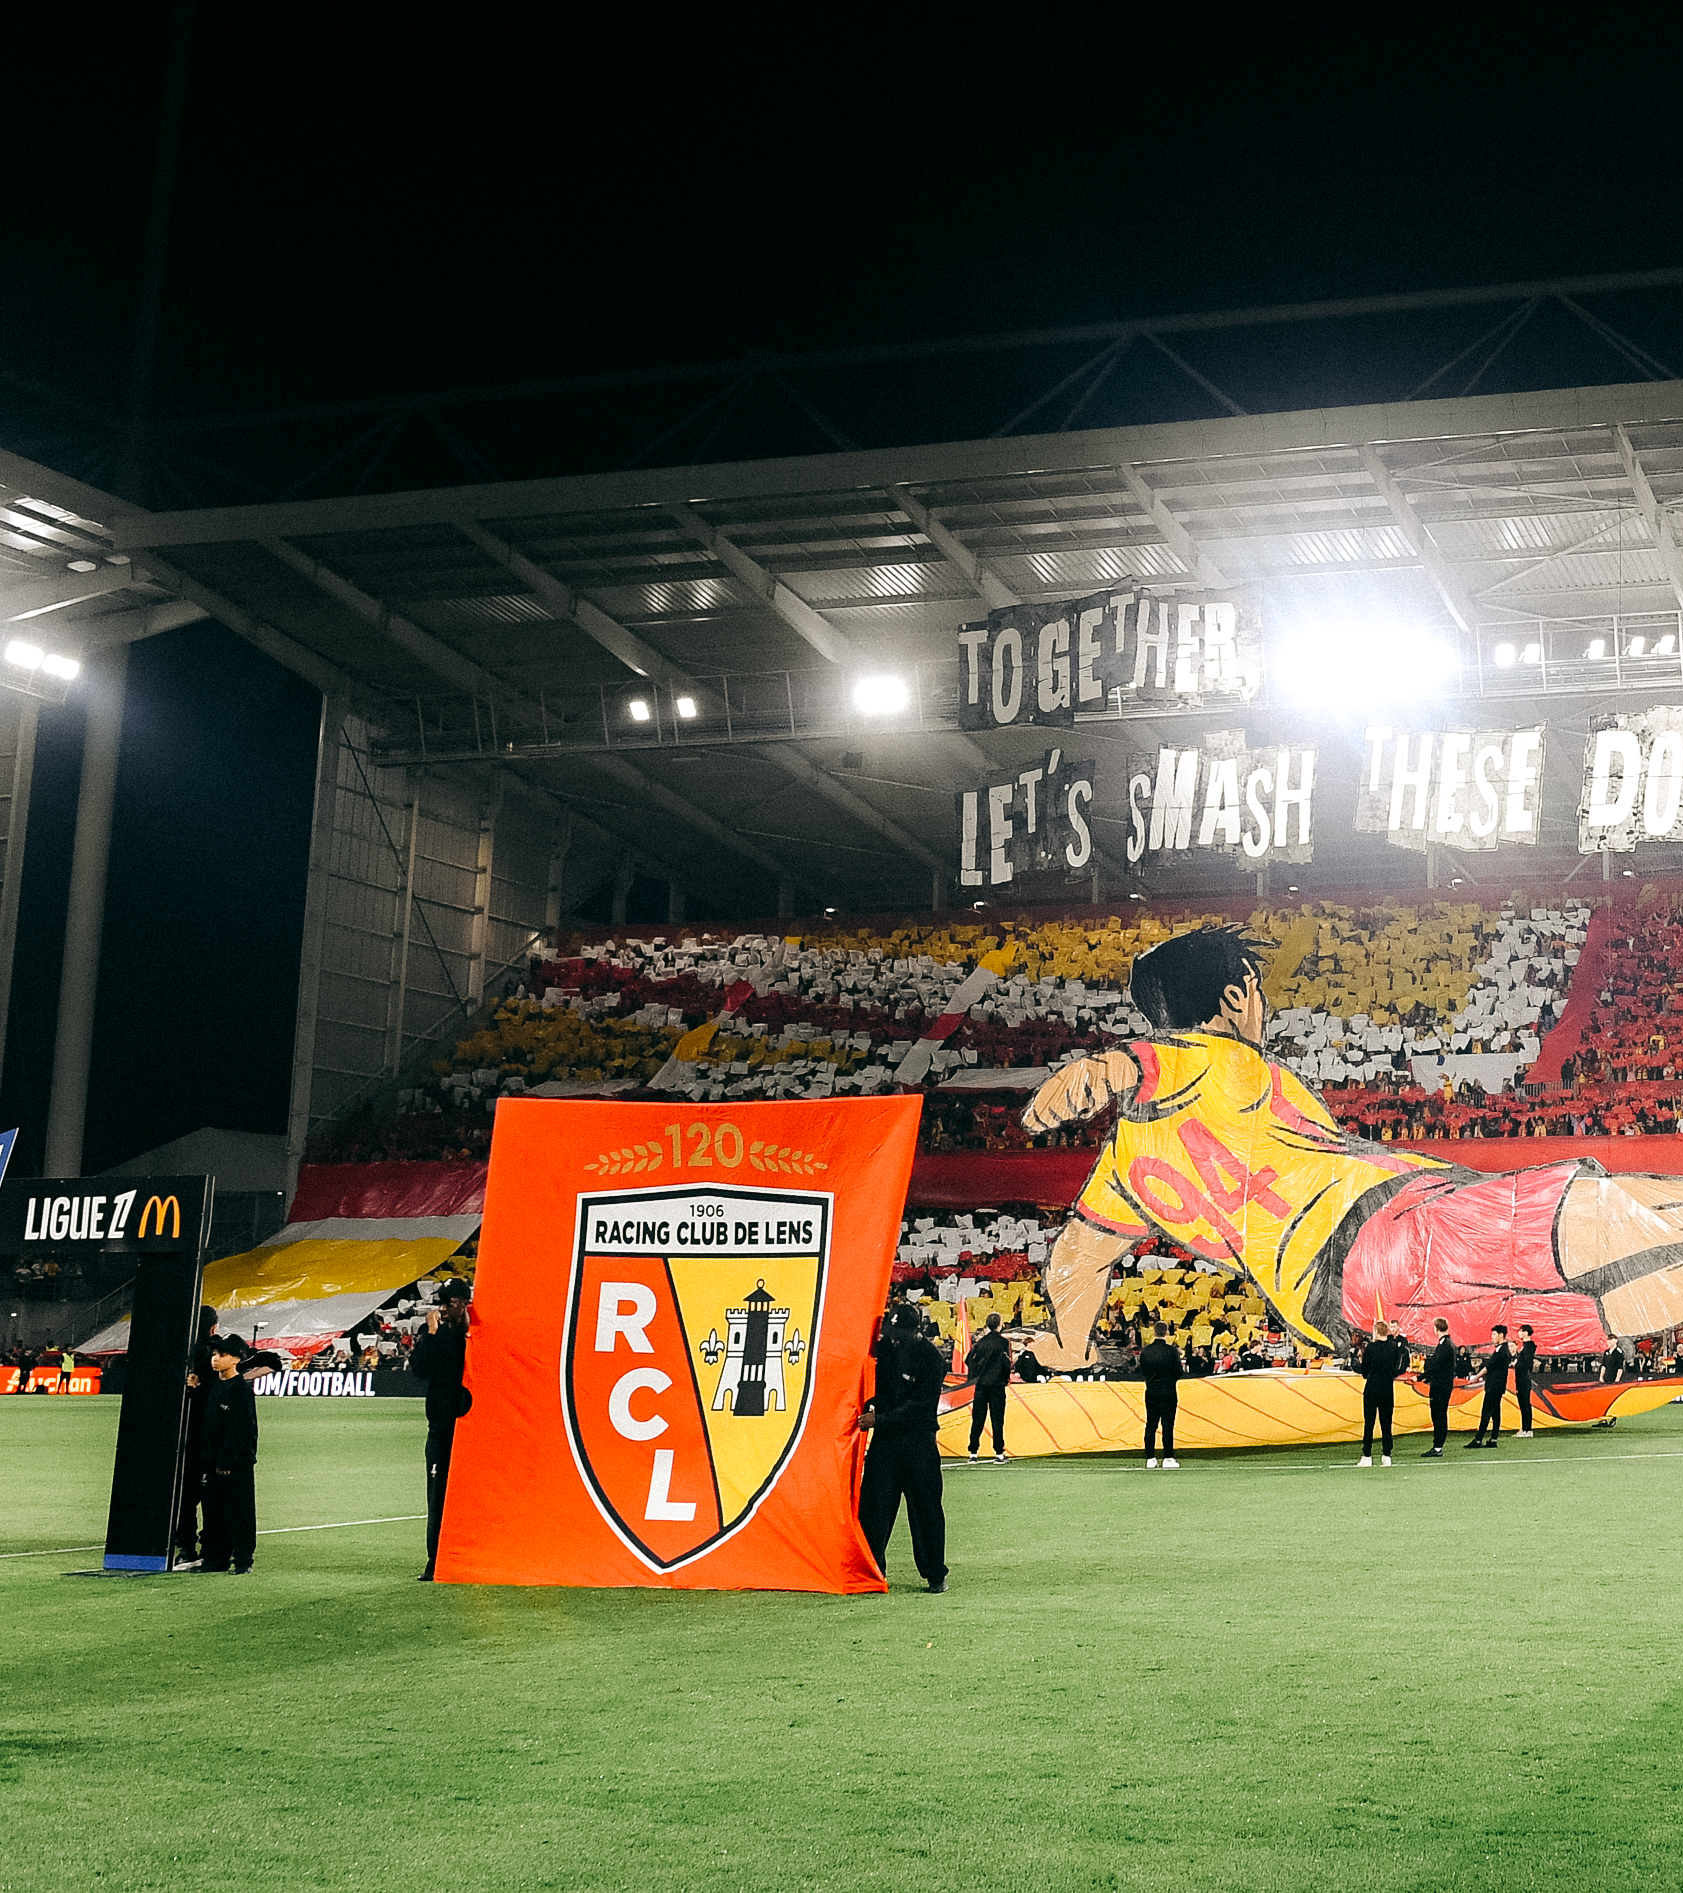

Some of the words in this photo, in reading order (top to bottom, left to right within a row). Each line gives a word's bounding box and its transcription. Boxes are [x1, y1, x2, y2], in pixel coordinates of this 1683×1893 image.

[960, 748, 1092, 886] LET'S
[1126, 749, 1315, 862] SMASH
[1365, 726, 1540, 837] THESE
[664, 1122, 746, 1168] 120
[689, 1204, 725, 1218] 1906
[1128, 1118, 1292, 1260] 94
[24, 1196, 107, 1240] LIGUE
[594, 1220, 671, 1245] RACING
[676, 1221, 729, 1246] CLUB
[734, 1221, 760, 1245] DE
[764, 1220, 813, 1245] LENS
